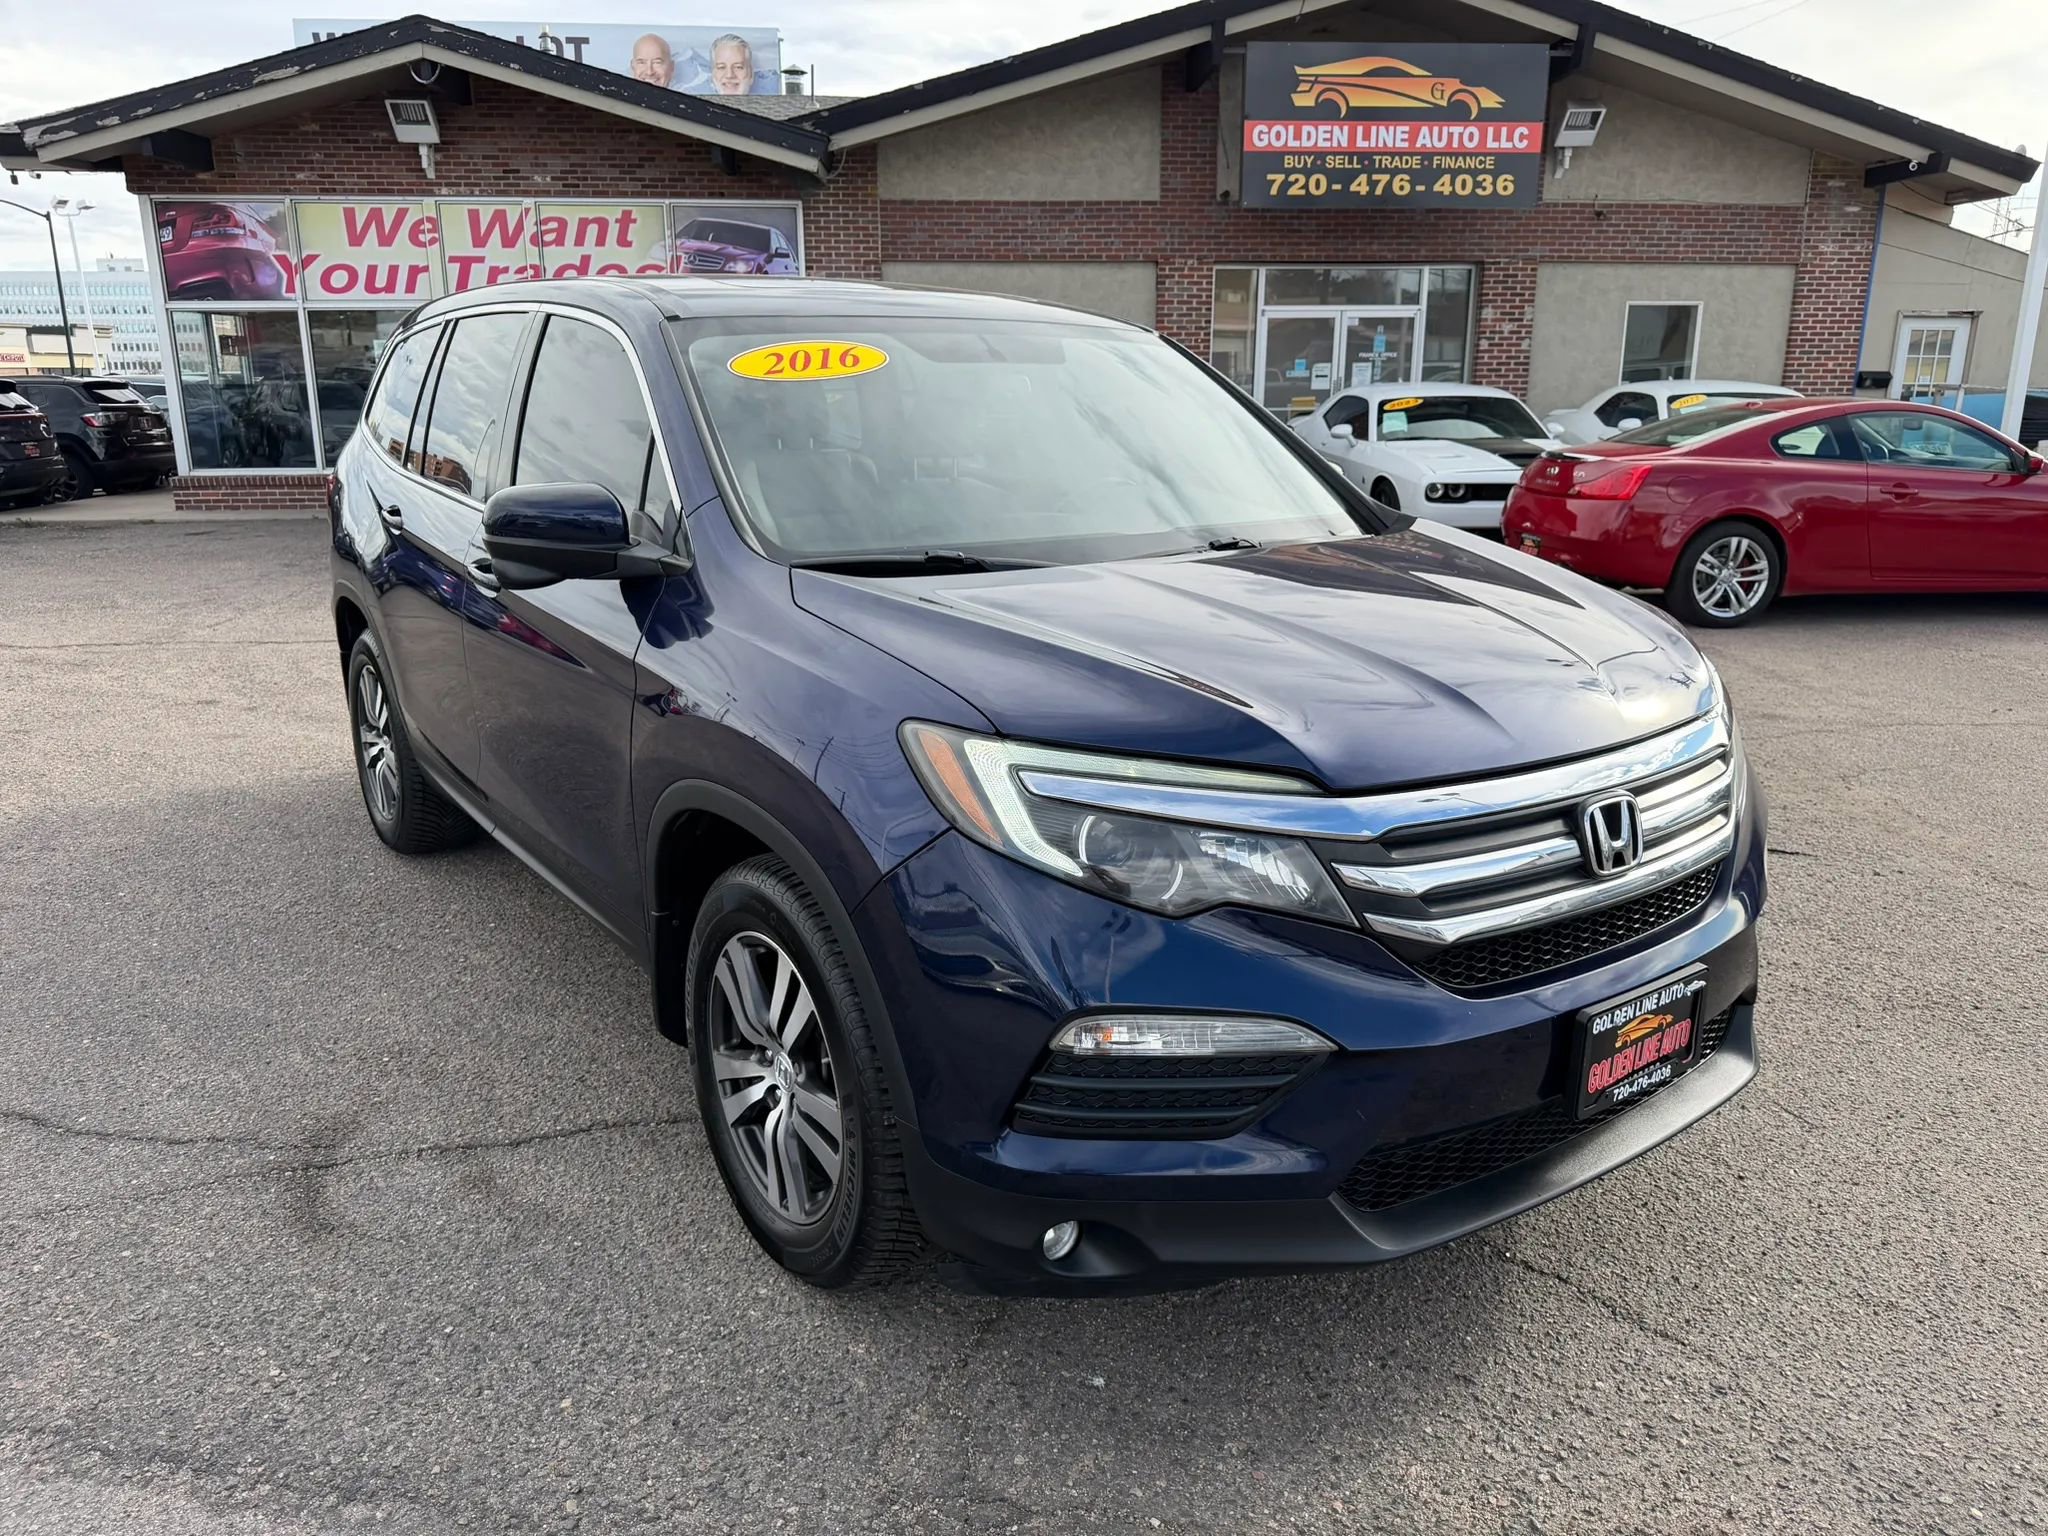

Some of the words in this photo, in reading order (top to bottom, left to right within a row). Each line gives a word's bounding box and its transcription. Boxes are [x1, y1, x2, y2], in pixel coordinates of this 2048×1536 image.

[1252, 124, 1348, 148] GOLDEN
[1356, 125, 1409, 149] LINE
[1415, 126, 1479, 149] AUTO
[1486, 126, 1529, 150] LLC
[1284, 155, 1314, 168] BUY
[1325, 155, 1361, 169] SELL
[1373, 155, 1421, 169] TRADE
[1433, 156, 1495, 169] FINANCE
[342, 206, 440, 249] We
[467, 207, 638, 249] Want
[272, 253, 430, 295] Your
[763, 346, 861, 376] 2016
[1593, 1003, 1635, 1035] GOLDEN
[1635, 994, 1660, 1017] LINE
[1659, 982, 1684, 1008] AUTO
[1588, 1044, 1636, 1094] GOLDEN
[1634, 1032, 1662, 1065] LINE
[1660, 1017, 1692, 1055] AUTO
[1613, 1064, 1672, 1102] 720-476-4036
